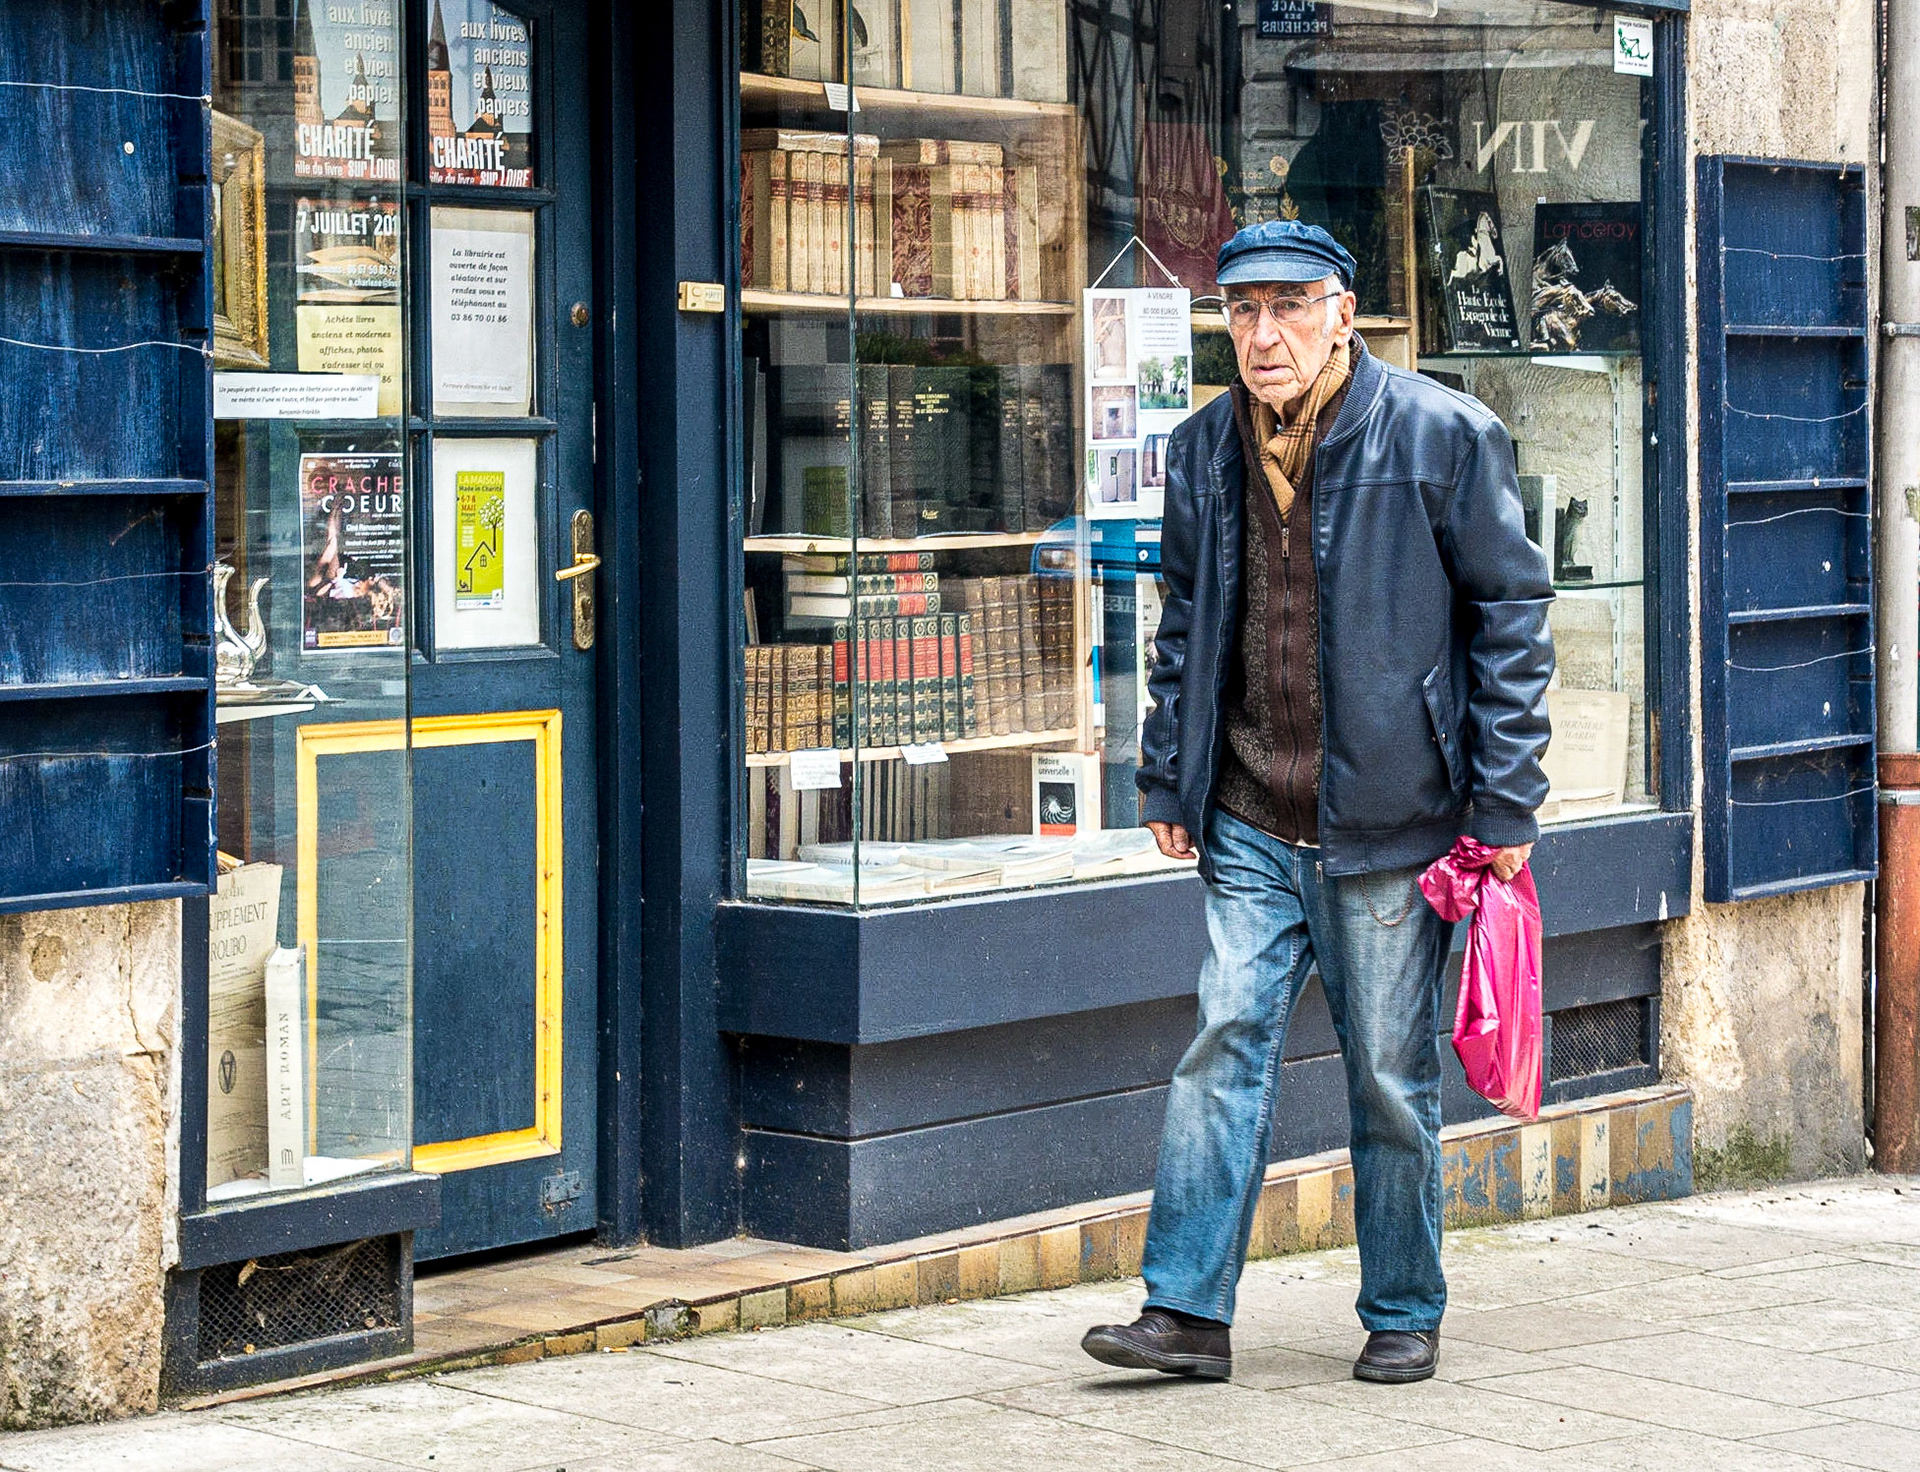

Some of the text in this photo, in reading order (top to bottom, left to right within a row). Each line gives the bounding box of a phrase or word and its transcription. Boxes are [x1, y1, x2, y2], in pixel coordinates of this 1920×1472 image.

[329, 2, 392, 27] aux livre
[461, 17, 526, 43] aux livres
[344, 28, 392, 52] ancien
[474, 43, 529, 68] anciens
[362, 54, 393, 78] vieu
[492, 68, 529, 92] vieux
[348, 81, 393, 106] papier
[477, 93, 530, 119] papiers
[299, 119, 375, 160] CHARITÉ
[433, 132, 505, 171] CHARITÉ
[369, 157, 400, 180] LOIR
[310, 211, 371, 236] JUILLET
[373, 213, 398, 237] 201
[452, 248, 462, 257] La
[464, 249, 494, 258] librairie
[448, 262, 509, 272] ouverte de façon
[450, 273, 485, 283] aléatoire
[478, 288, 496, 296] vous
[1457, 290, 1482, 307] Haute
[450, 298, 508, 309] téléphonant au
[355, 314, 376, 324] livres
[450, 313, 461, 321] 03
[474, 314, 485, 322] 70
[486, 314, 496, 323] 01
[1459, 306, 1510, 325] Espagnole de
[311, 329, 392, 339] anciens et modernes
[1483, 322, 1512, 338] Vienne
[321, 360, 361, 369] s'adresser
[362, 360, 373, 369] ici
[381, 375, 392, 384] 86
[311, 475, 402, 494] CRACHE
[470, 475, 503, 486] MAISON
[210, 934, 248, 962] ROUBO
[278, 1011, 292, 1122] ART ROMAN
